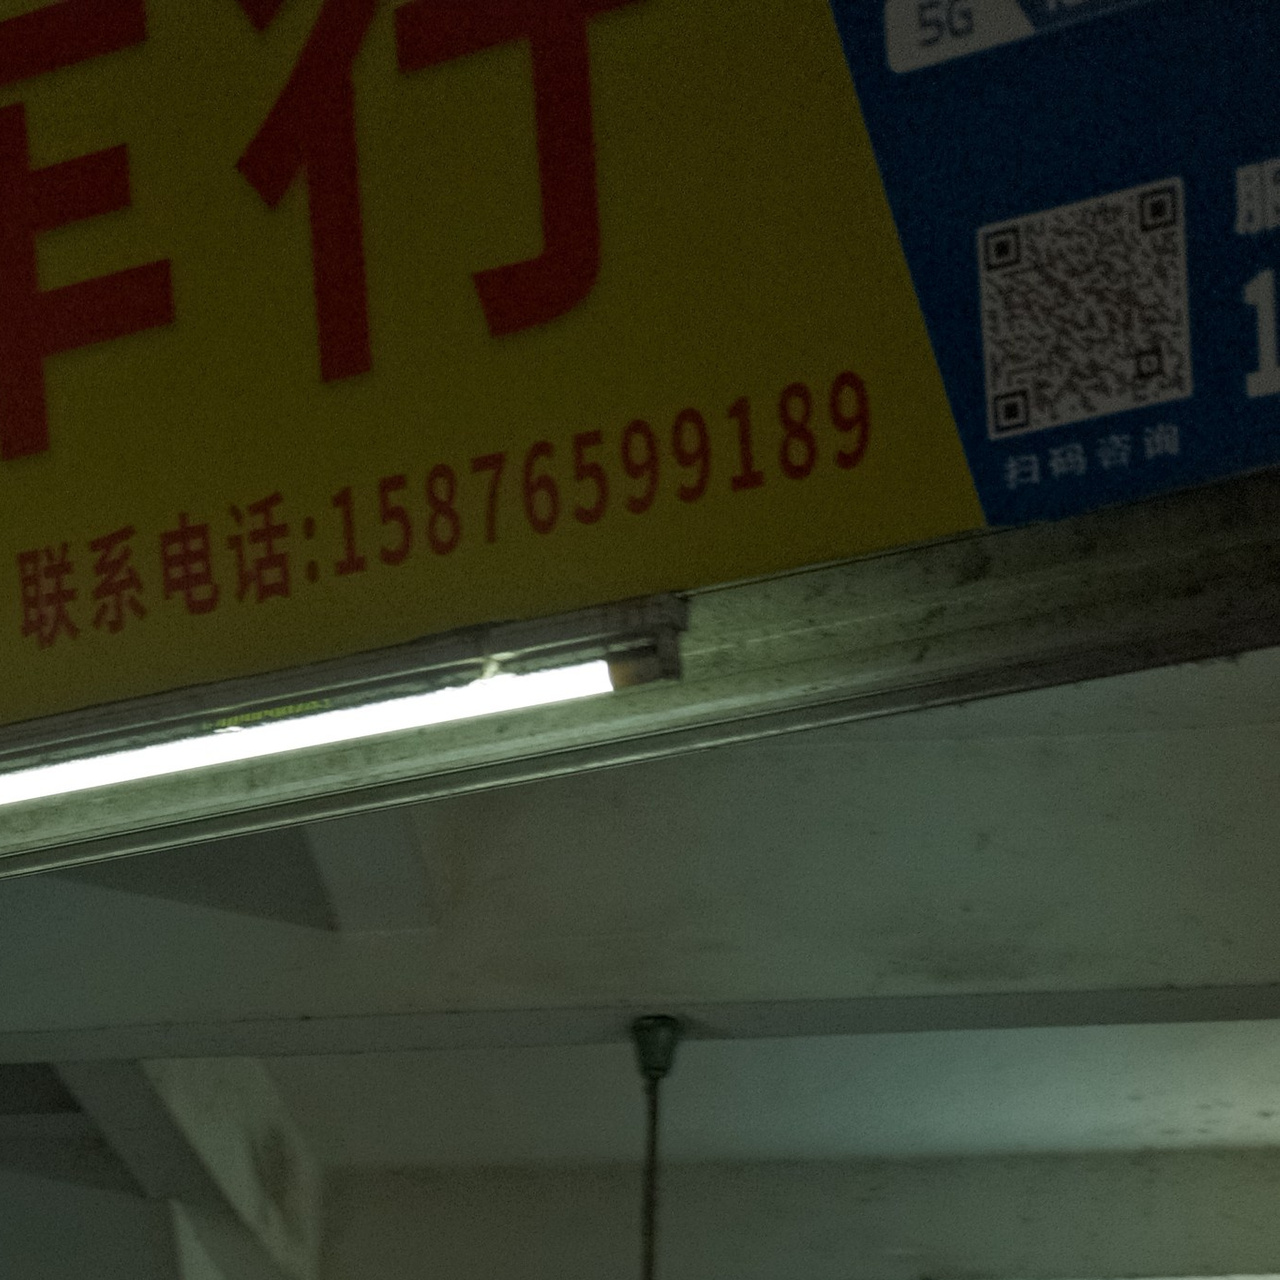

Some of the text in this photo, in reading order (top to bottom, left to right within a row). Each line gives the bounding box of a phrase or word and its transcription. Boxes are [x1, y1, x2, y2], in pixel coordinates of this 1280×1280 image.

[917, 0, 974, 47] 5G
[1003, 422, 1181, 490] 扫码咨询
